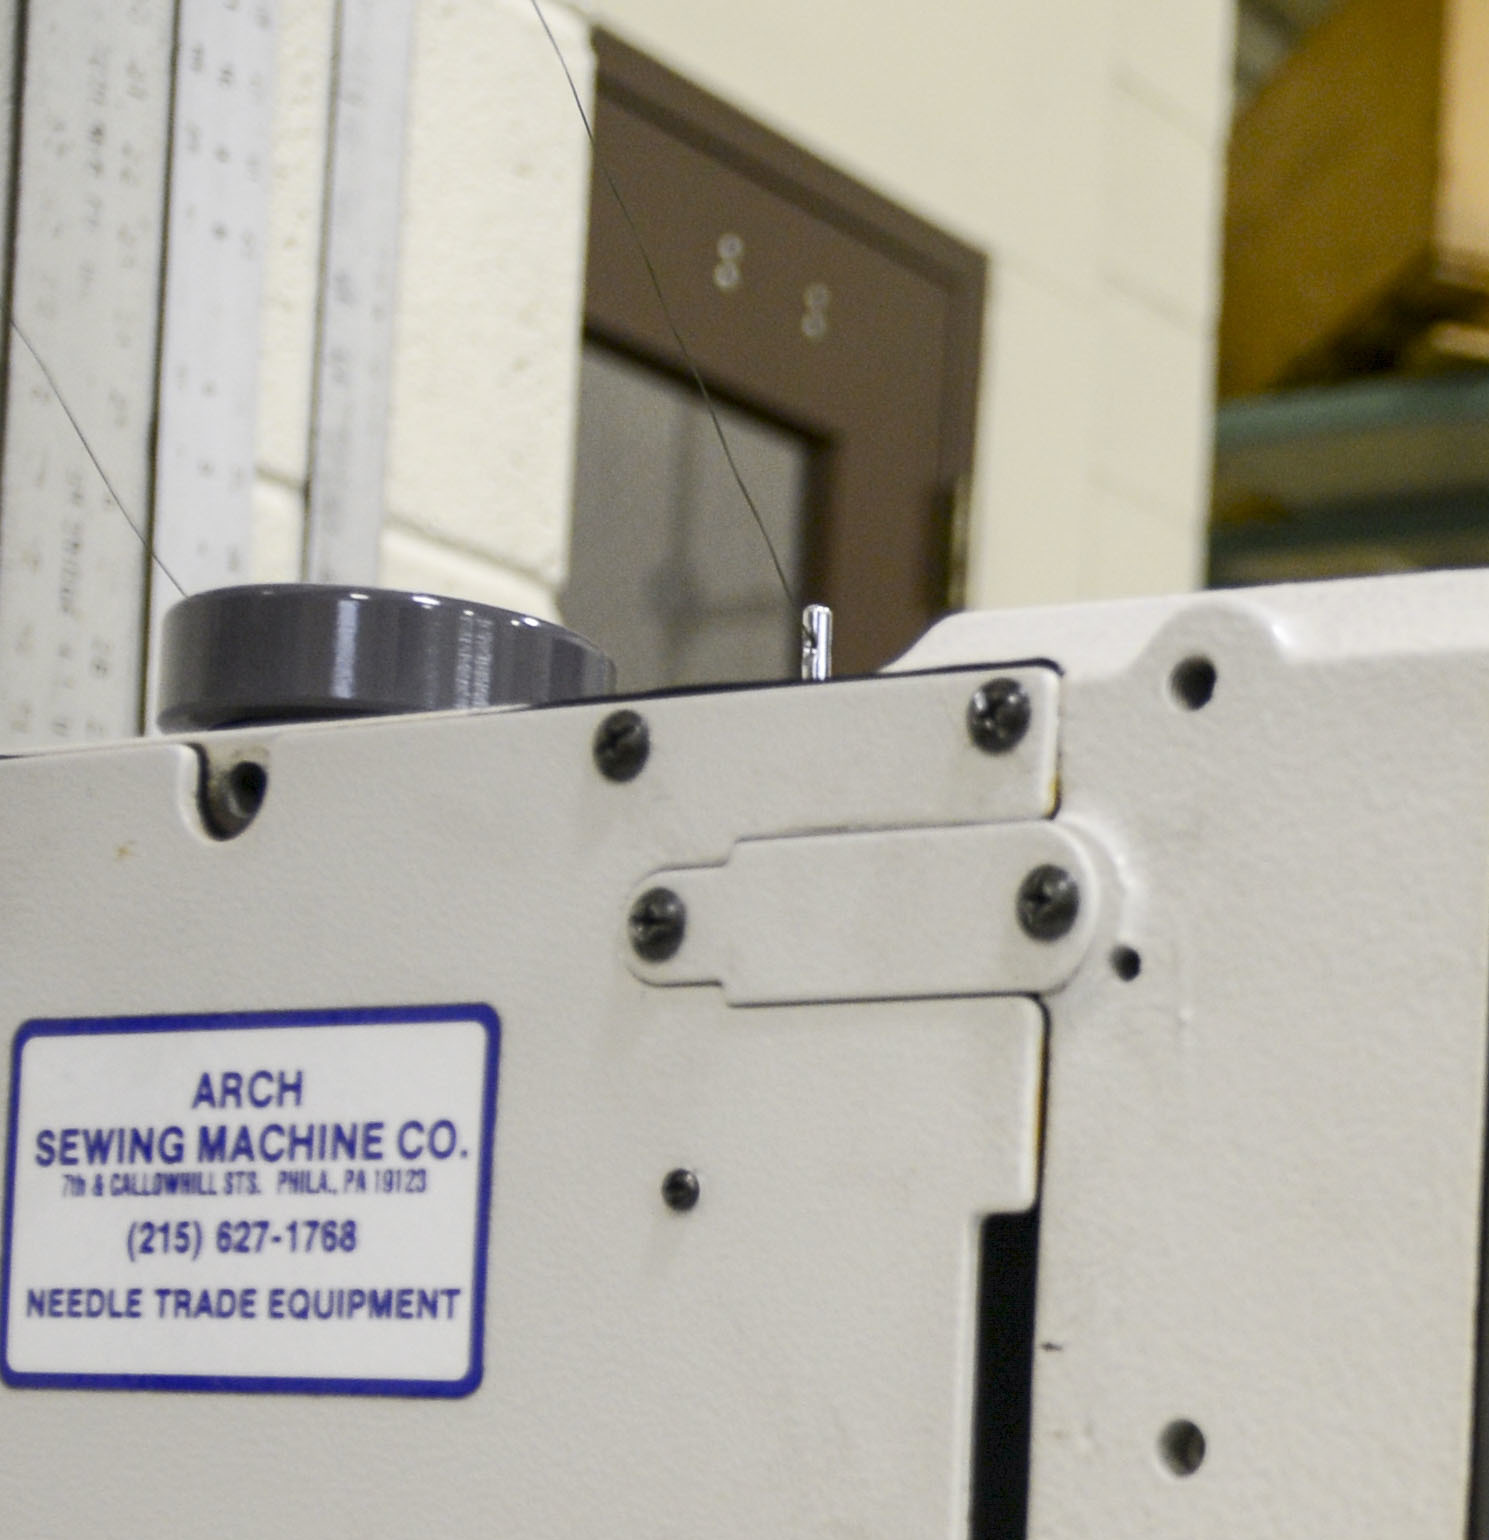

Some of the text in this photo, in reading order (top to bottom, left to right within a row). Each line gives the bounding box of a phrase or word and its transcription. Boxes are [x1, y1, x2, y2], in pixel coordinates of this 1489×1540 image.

[191, 1070, 304, 1110] ARCH
[34, 1119, 470, 1168] SEWING MACHINE CO.
[110, 1172, 218, 1197] CALLOWHILL
[223, 1171, 262, 1196] STS.
[344, 1169, 368, 1195] PA
[374, 1168, 428, 1194] 19123
[126, 1219, 359, 1262] (215) 627-1768
[26, 1288, 462, 1321] NEEDLE TRADE EQUIPMENT
